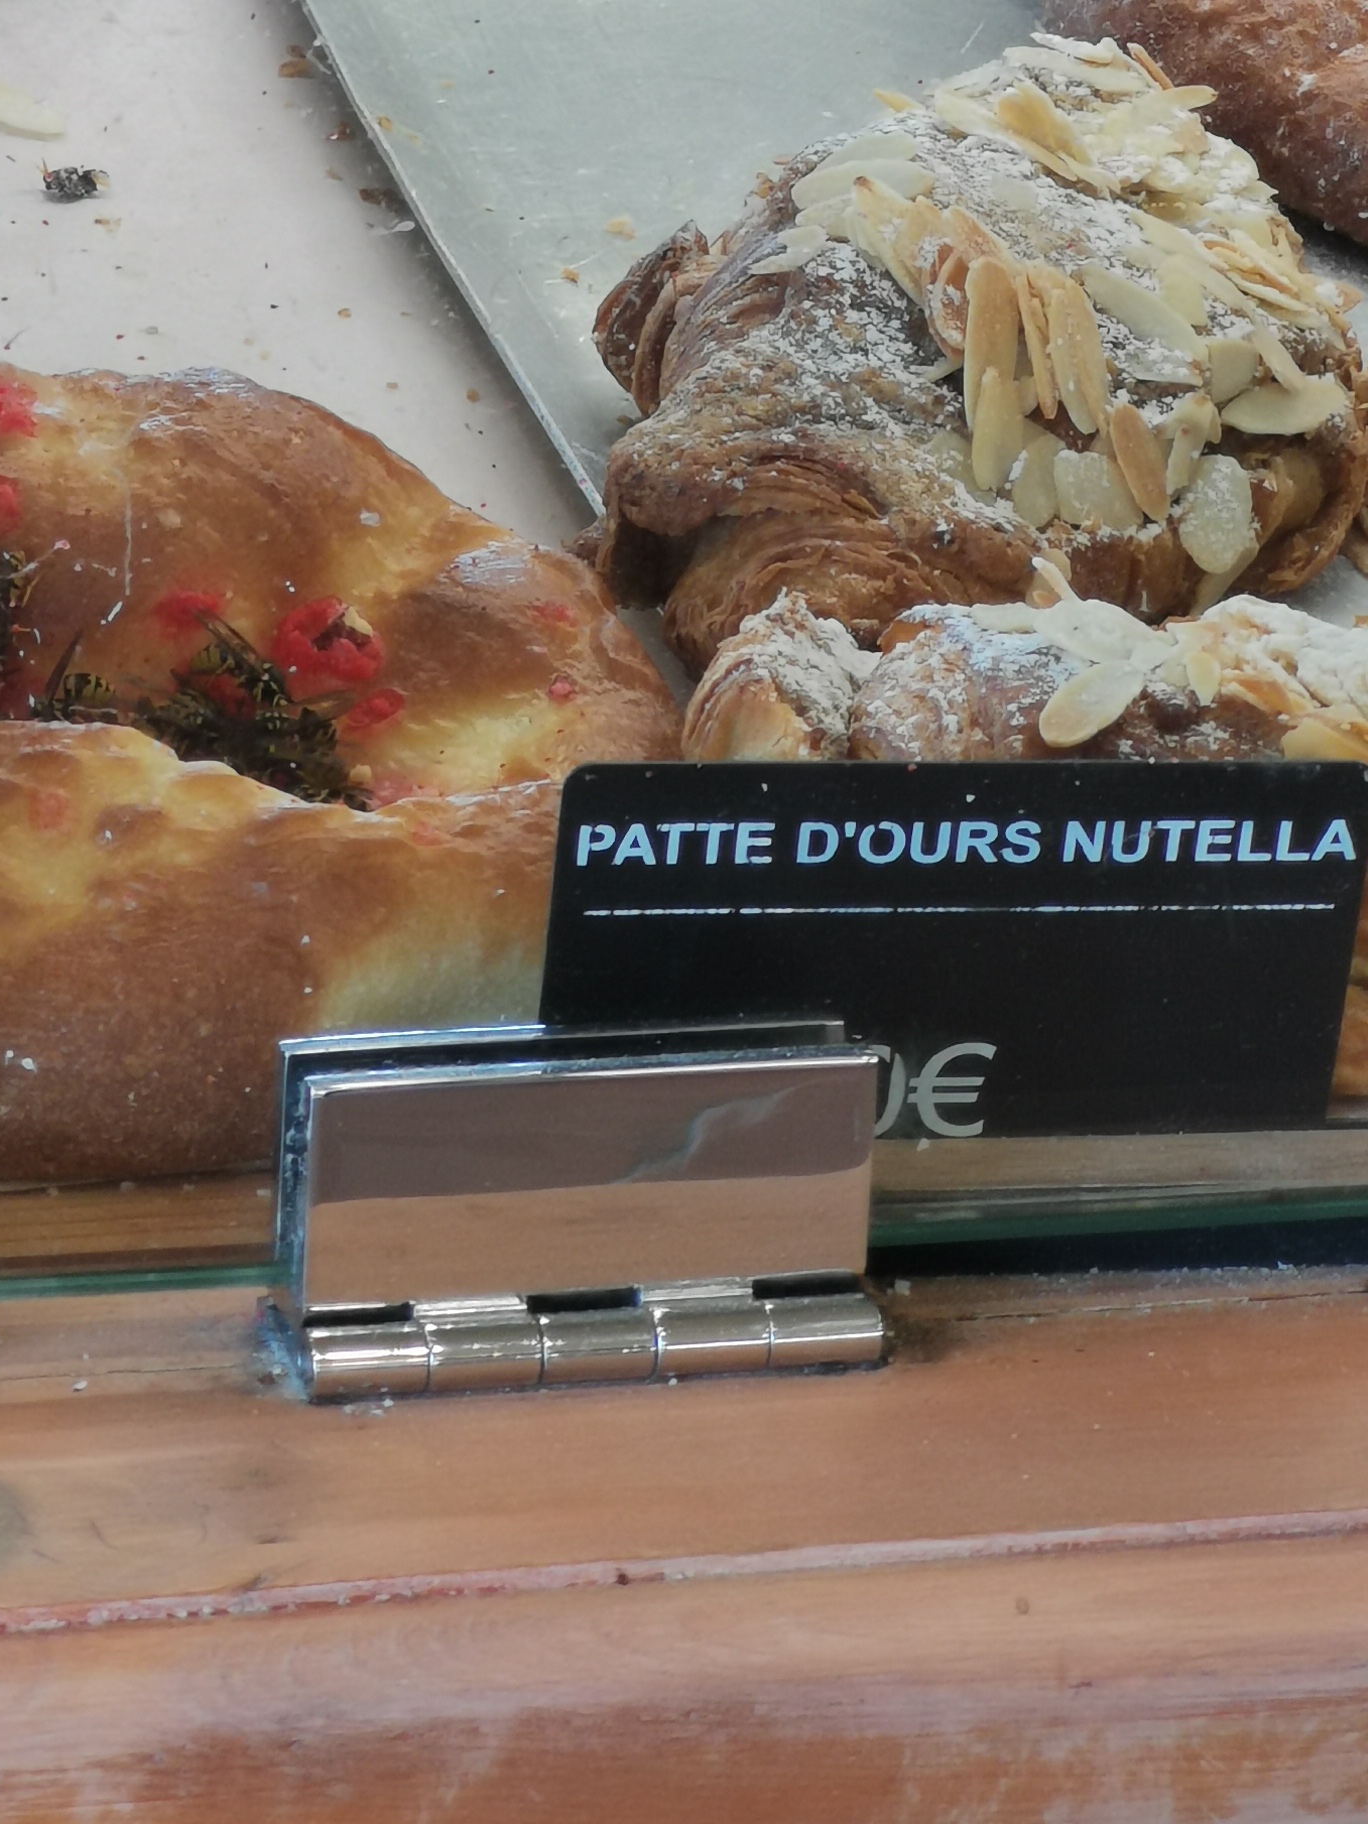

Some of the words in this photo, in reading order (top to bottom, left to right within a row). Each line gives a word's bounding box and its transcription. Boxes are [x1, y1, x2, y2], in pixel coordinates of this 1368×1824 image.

[575, 822, 776, 866] PATTE
[796, 819, 1041, 864] D'OURS
[1062, 818, 1356, 863] NUTELLA
